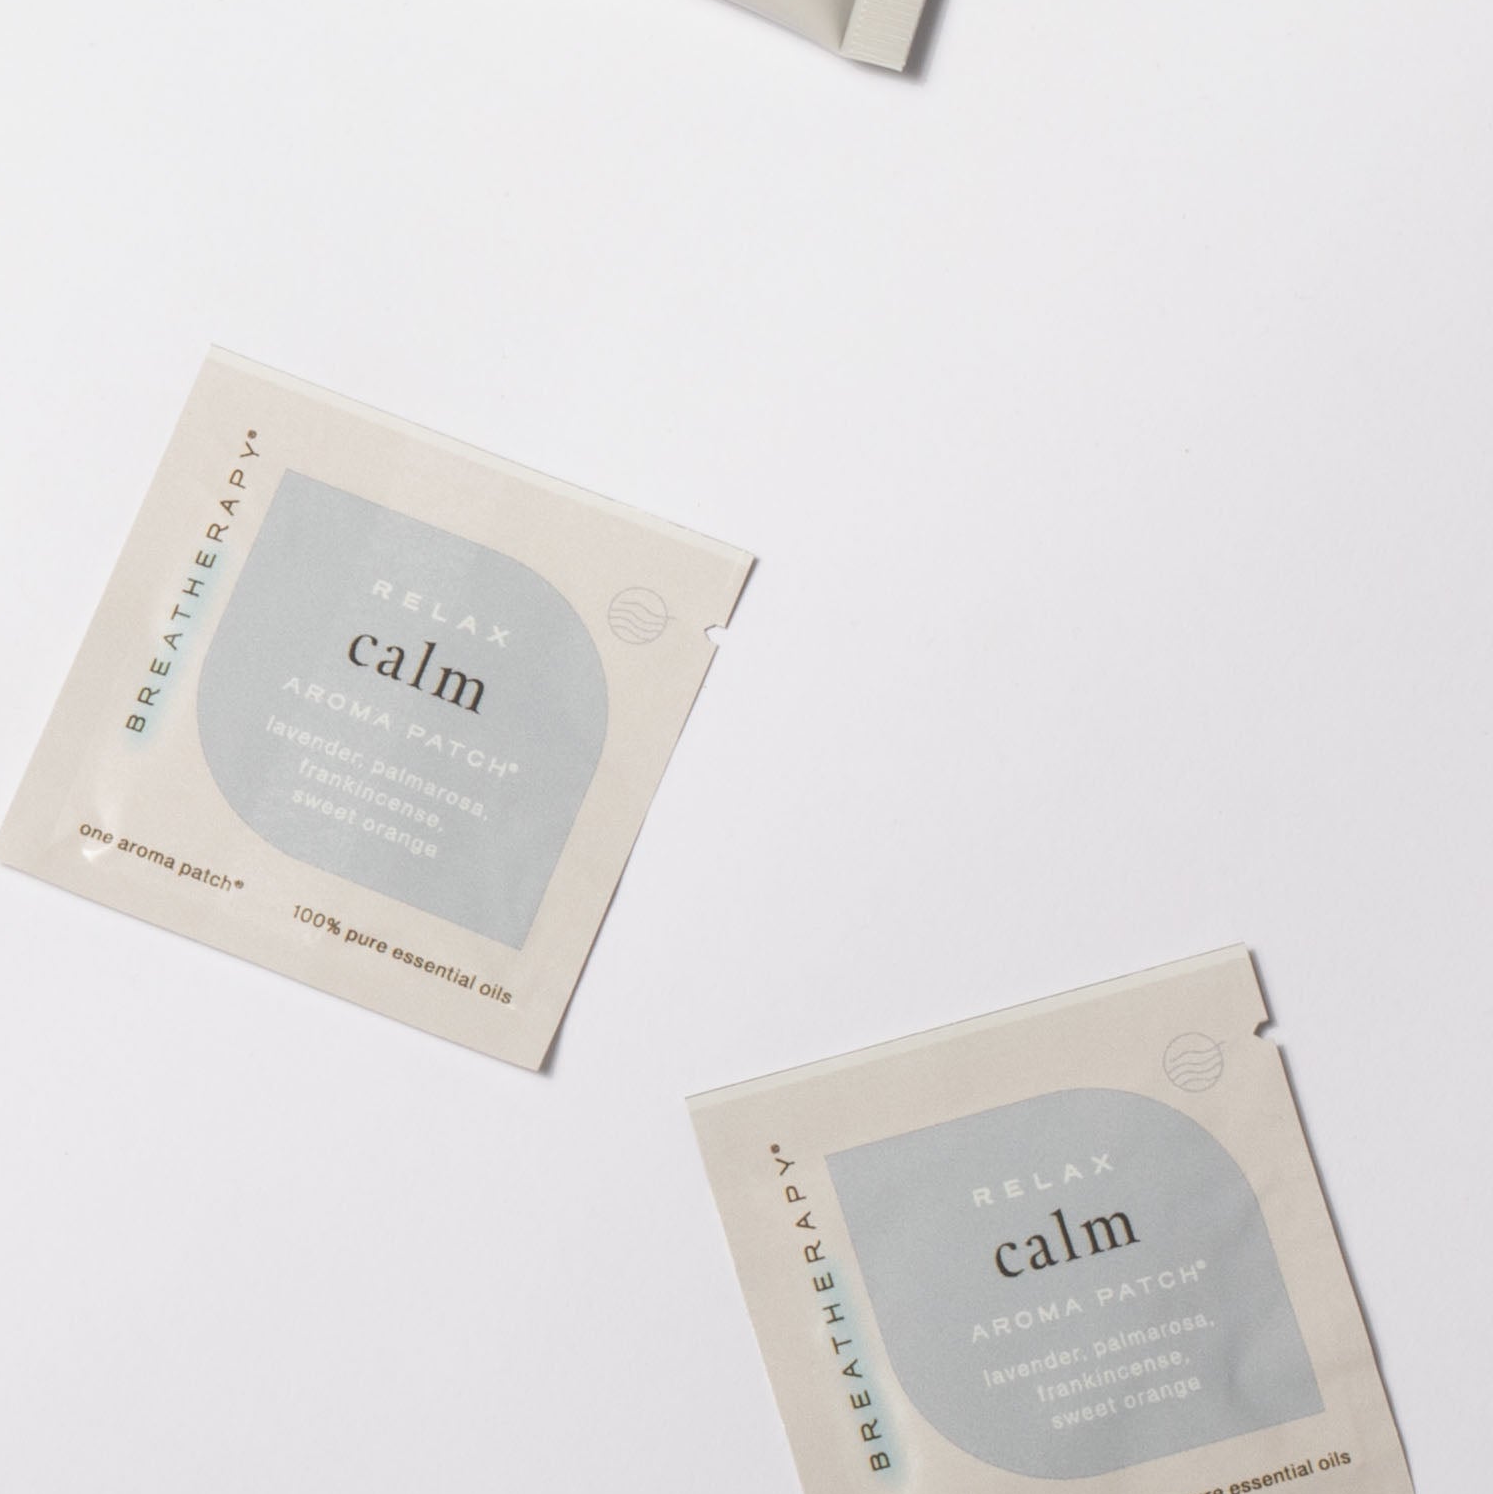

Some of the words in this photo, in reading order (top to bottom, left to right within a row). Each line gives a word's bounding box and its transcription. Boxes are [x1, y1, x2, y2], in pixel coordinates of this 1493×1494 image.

[370, 578, 511, 648] RELAX
[281, 676, 391, 731] AROMA
[347, 634, 485, 715] calm
[265, 714, 364, 769] lavender,
[368, 755, 489, 822] palmarosa,
[297, 755, 444, 833] frankincense,
[78, 823, 114, 845] one
[116, 837, 176, 871] aroma
[290, 789, 358, 825] sweet
[359, 816, 438, 859] orange
[293, 904, 342, 937] 100%
[343, 928, 389, 954] pure
[391, 947, 477, 990] essential
[478, 982, 513, 1005] oils
[971, 1152, 1114, 1208] RELAX
[994, 1208, 1141, 1279] calm
[971, 1297, 1084, 1344] AROMA
[982, 1347, 1088, 1388] lavender,
[1091, 1313, 1216, 1360] palmarosa,
[1035, 1350, 1191, 1404] frankincense,
[1050, 1396, 1118, 1430] sweet
[1123, 1375, 1202, 1410] orange
[1317, 1451, 1352, 1472] oils
